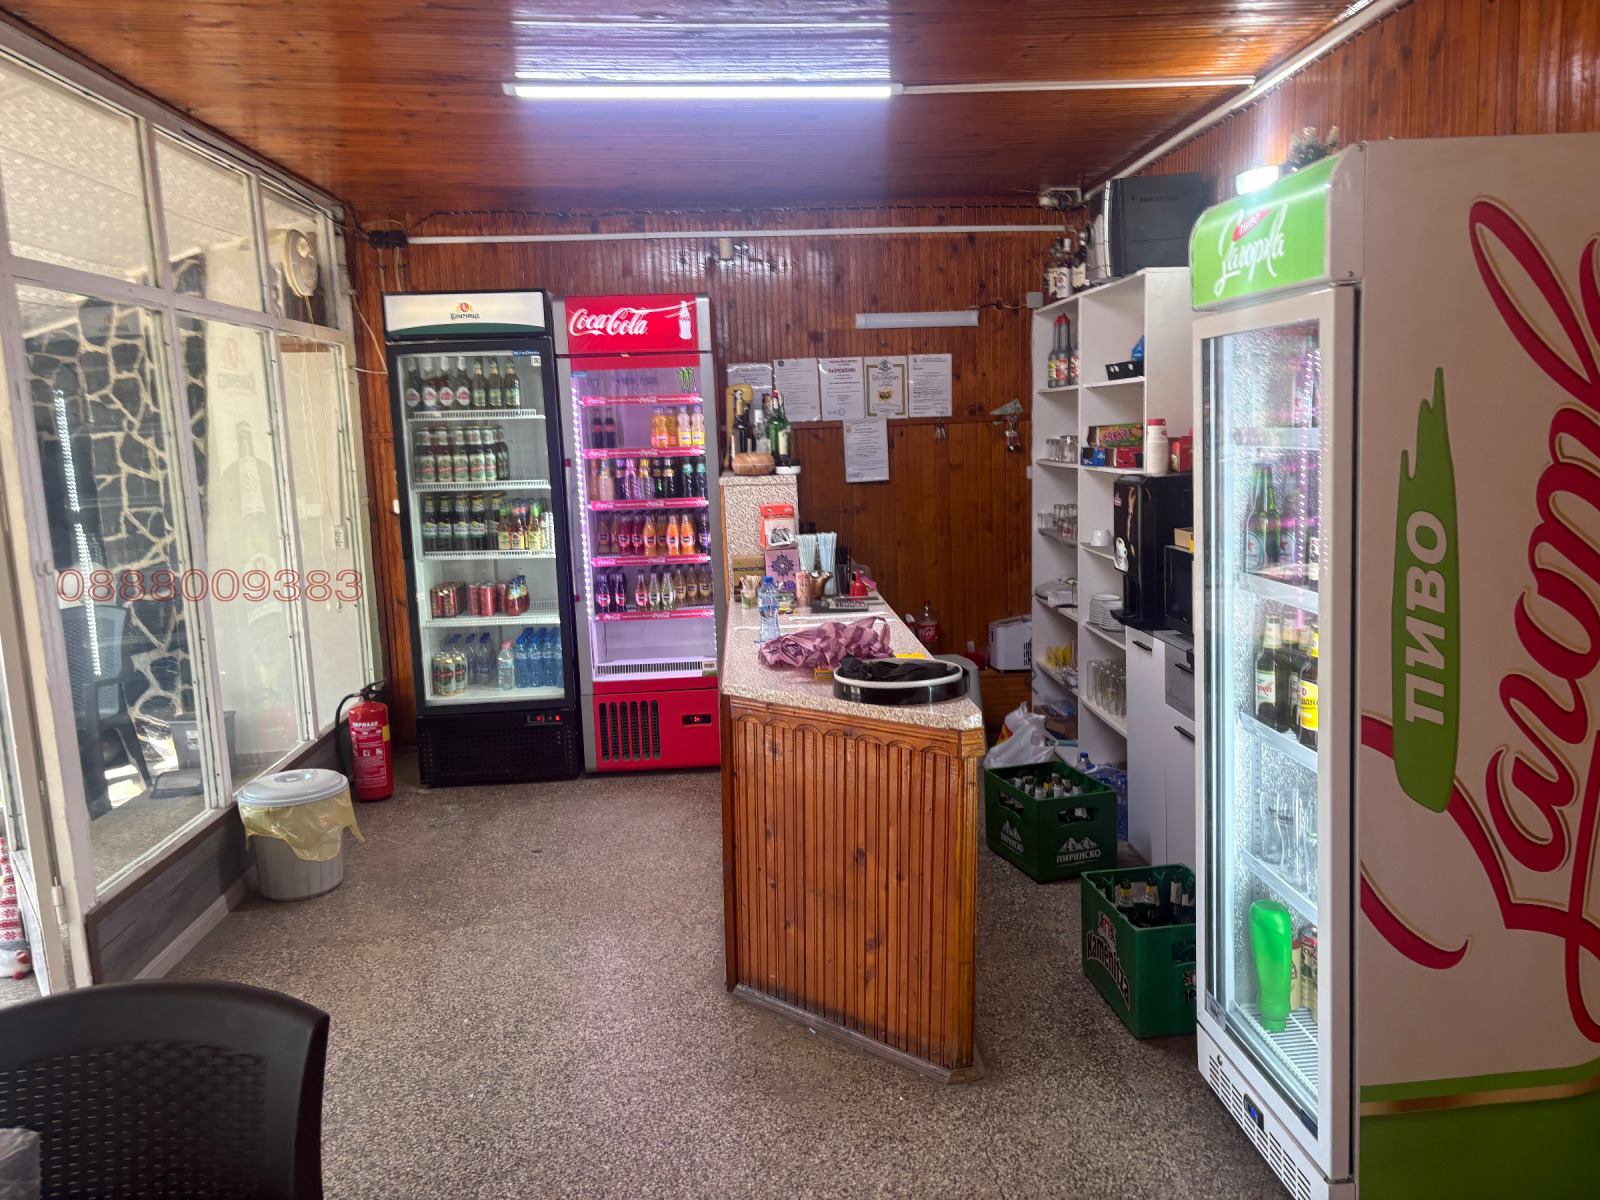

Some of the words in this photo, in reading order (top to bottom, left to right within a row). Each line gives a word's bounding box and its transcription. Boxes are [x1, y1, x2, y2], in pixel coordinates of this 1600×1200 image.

[1213, 200, 1288, 297] Загорка
[1361, 190, 1600, 1042] Загорк
[1405, 510, 1447, 726] ПИВО
[1056, 849, 1102, 863] ПИРИНСКО
[1087, 931, 1130, 1011] Kamenitza
